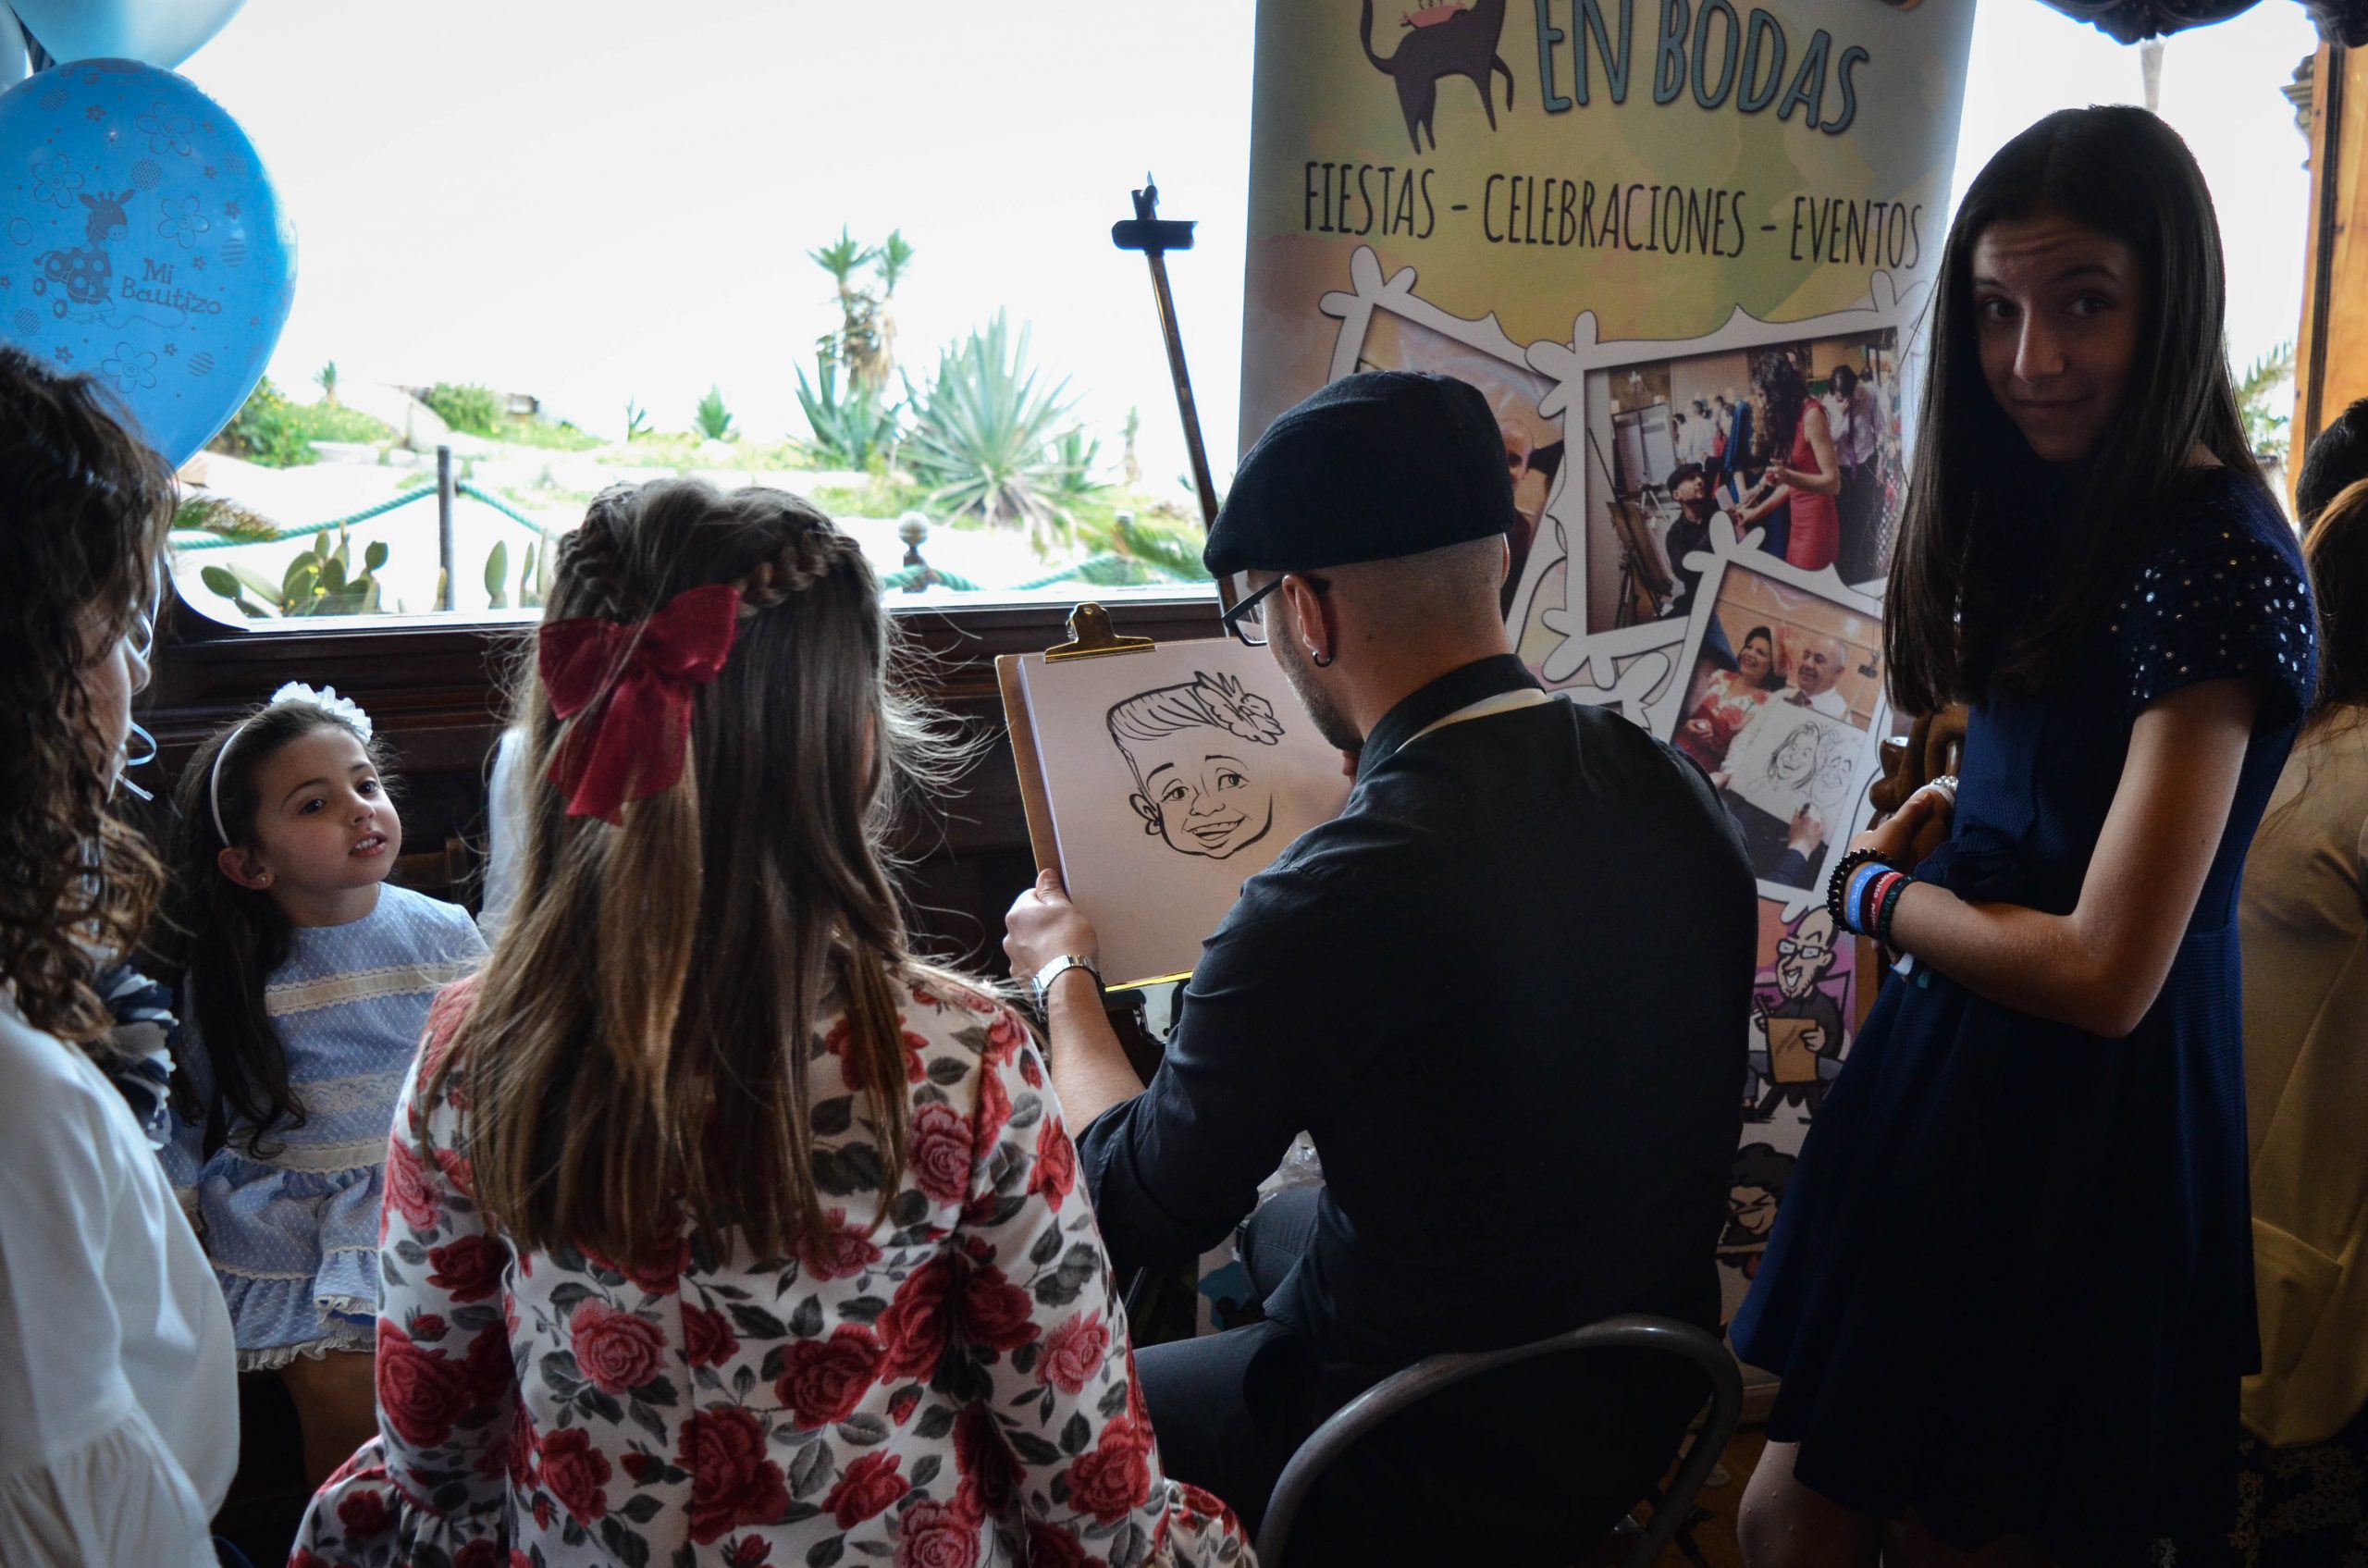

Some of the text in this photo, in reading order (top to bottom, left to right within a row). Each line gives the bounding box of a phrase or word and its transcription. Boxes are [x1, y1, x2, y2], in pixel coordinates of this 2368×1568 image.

[1535, 0, 1870, 135] EN BODAS
[1304, 161, 1436, 240] FIESTAS
[1483, 173, 1746, 259] CELEBRACIONES
[1790, 195, 1923, 270] EVENTOS
[121, 275, 222, 315] Bautizo
[142, 257, 175, 286] Mi
